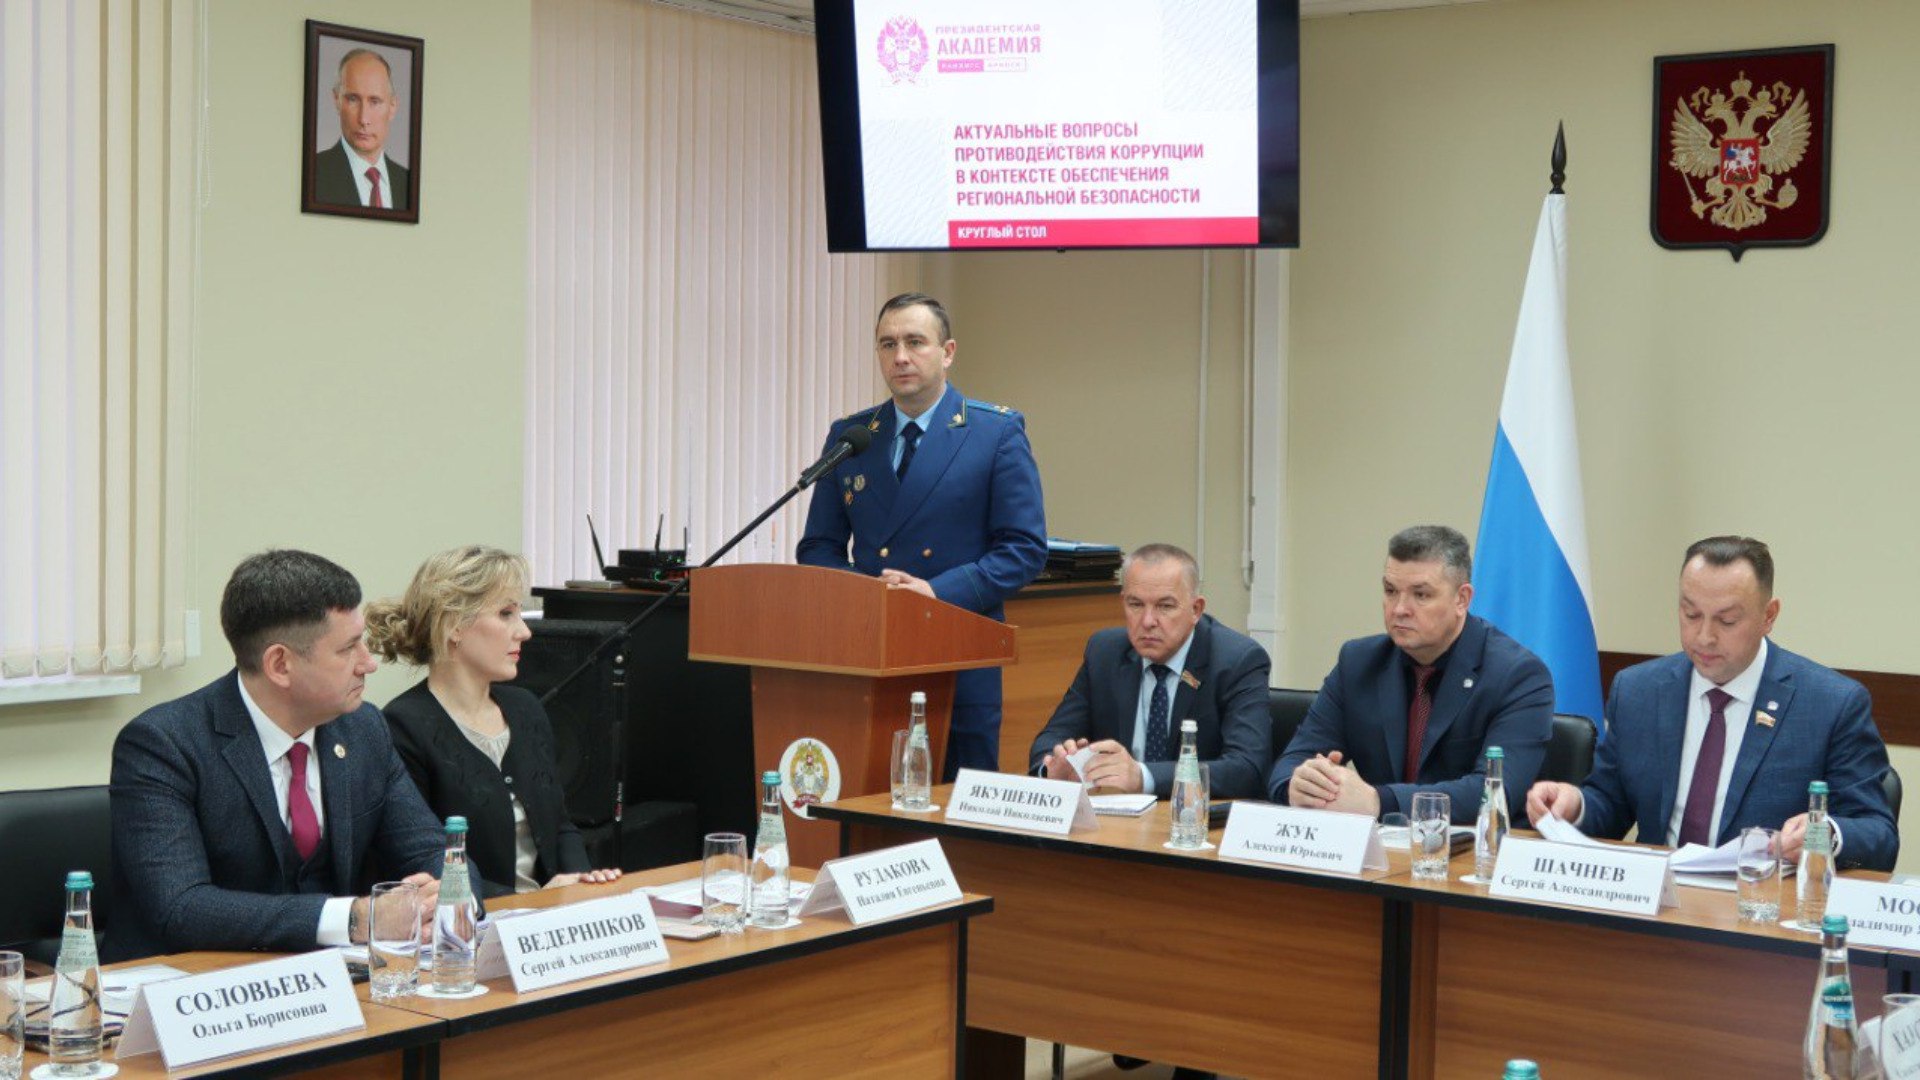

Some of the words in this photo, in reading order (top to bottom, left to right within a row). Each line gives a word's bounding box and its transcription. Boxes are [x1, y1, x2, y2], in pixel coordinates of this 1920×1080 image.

[935, 24, 1041, 34] ПРЕЗИДЕНТСКАЯ
[937, 36, 1042, 55] АКАДЕМИЯ
[954, 123, 1058, 140] АКТУАЛЬНЫЕ
[1062, 122, 1138, 138] ВОПРОСЫ
[955, 143, 1106, 163] ПРОТИВОДЕЙСТВИЯ
[1111, 143, 1205, 161] КОРРУПЦИИ
[956, 169, 966, 184] В
[970, 168, 1057, 184] КОНТЕКСТЕ
[1061, 166, 1170, 183] ОБЕСПЕЧЕНИЯ
[957, 187, 1076, 206] РЕГИОНАЛЬНОЙ
[1080, 188, 1201, 205] БЕЗОПАСНОСТИ
[957, 224, 1014, 238] КРУГЛЫЙ
[1016, 226, 1047, 238] СТОЛ
[969, 784, 1063, 808] ЯКУШЕНКО
[959, 801, 1001, 815] Николай
[1003, 807, 1065, 825] Николаевич
[1276, 823, 1319, 841] ЖУК
[1242, 840, 1287, 855] Алексей
[1290, 844, 1343, 862] Юрьевич
[854, 856, 931, 888] РУДАКОВА
[1533, 857, 1627, 883] ШАЧНЕВ
[895, 877, 948, 898] Евгеньевна
[1501, 873, 1546, 890] Сергей
[1549, 882, 1651, 905] Александрович
[1877, 895, 1920, 916] МО
[517, 913, 646, 955] ВЕДЕРНИКОВ
[1850, 919, 1914, 936] ладимир
[520, 956, 566, 977] Сергей
[569, 938, 659, 966] Александрович
[175, 971, 328, 1017] СОЛОВЬЕВА
[192, 1020, 244, 1039] Ольга
[245, 1002, 328, 1028] Борисовна
